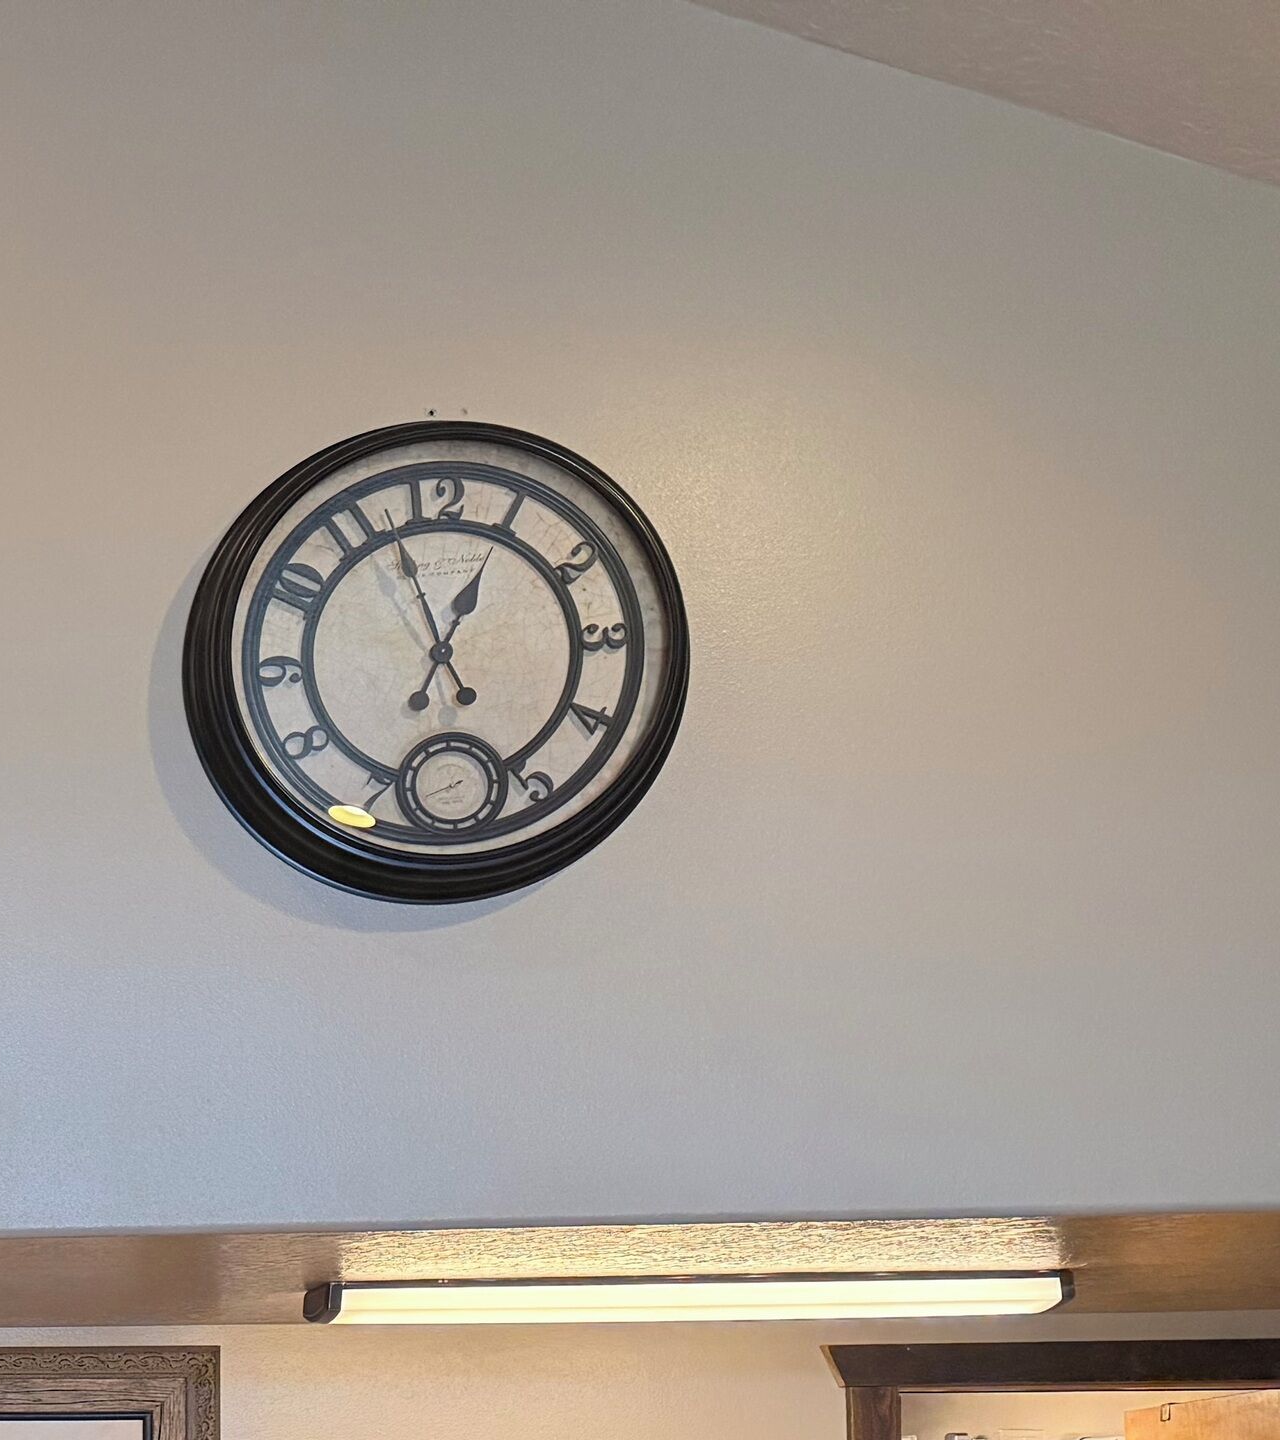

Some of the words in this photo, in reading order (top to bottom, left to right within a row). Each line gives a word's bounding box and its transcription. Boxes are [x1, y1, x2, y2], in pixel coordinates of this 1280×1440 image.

[406, 478, 465, 522] 12
[492, 490, 527, 537] 1
[325, 503, 382, 562] 11
[553, 541, 599, 584] 2
[271, 562, 326, 621] 10
[582, 623, 628, 650] 3
[258, 656, 303, 687] 9
[570, 702, 615, 735] 4
[283, 725, 329, 760] 8
[365, 770, 397, 813] 7
[507, 758, 554, 801] 5
